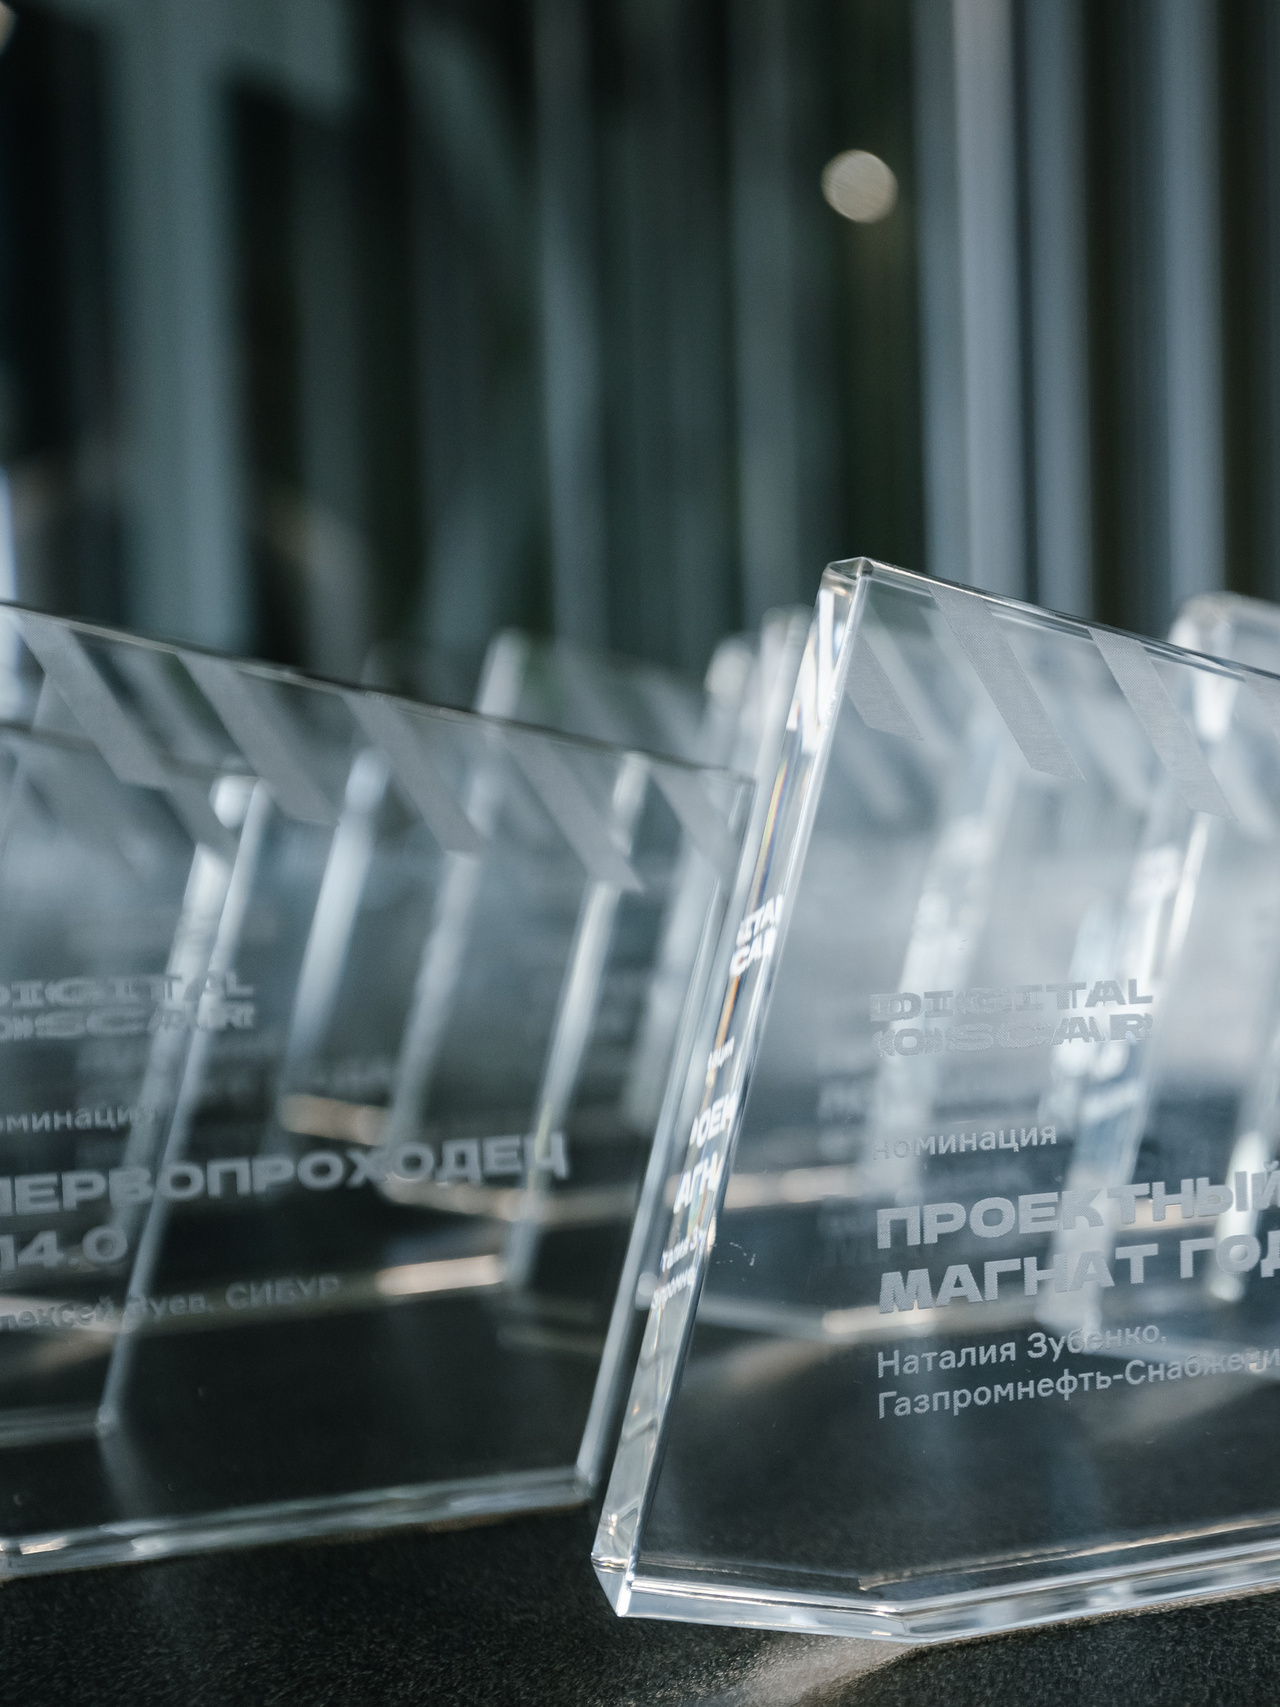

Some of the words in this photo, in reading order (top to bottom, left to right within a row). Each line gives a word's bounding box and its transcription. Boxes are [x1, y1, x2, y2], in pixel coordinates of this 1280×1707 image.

[870, 979, 1153, 1022] DIGITAL
[873, 1013, 1153, 1057] OSCAR
[872, 1125, 1057, 1160] номинация
[879, 1244, 1159, 1314] МАГНАТ
[877, 1341, 1017, 1378] Наталия
[1027, 1323, 1168, 1363] Зубенко,
